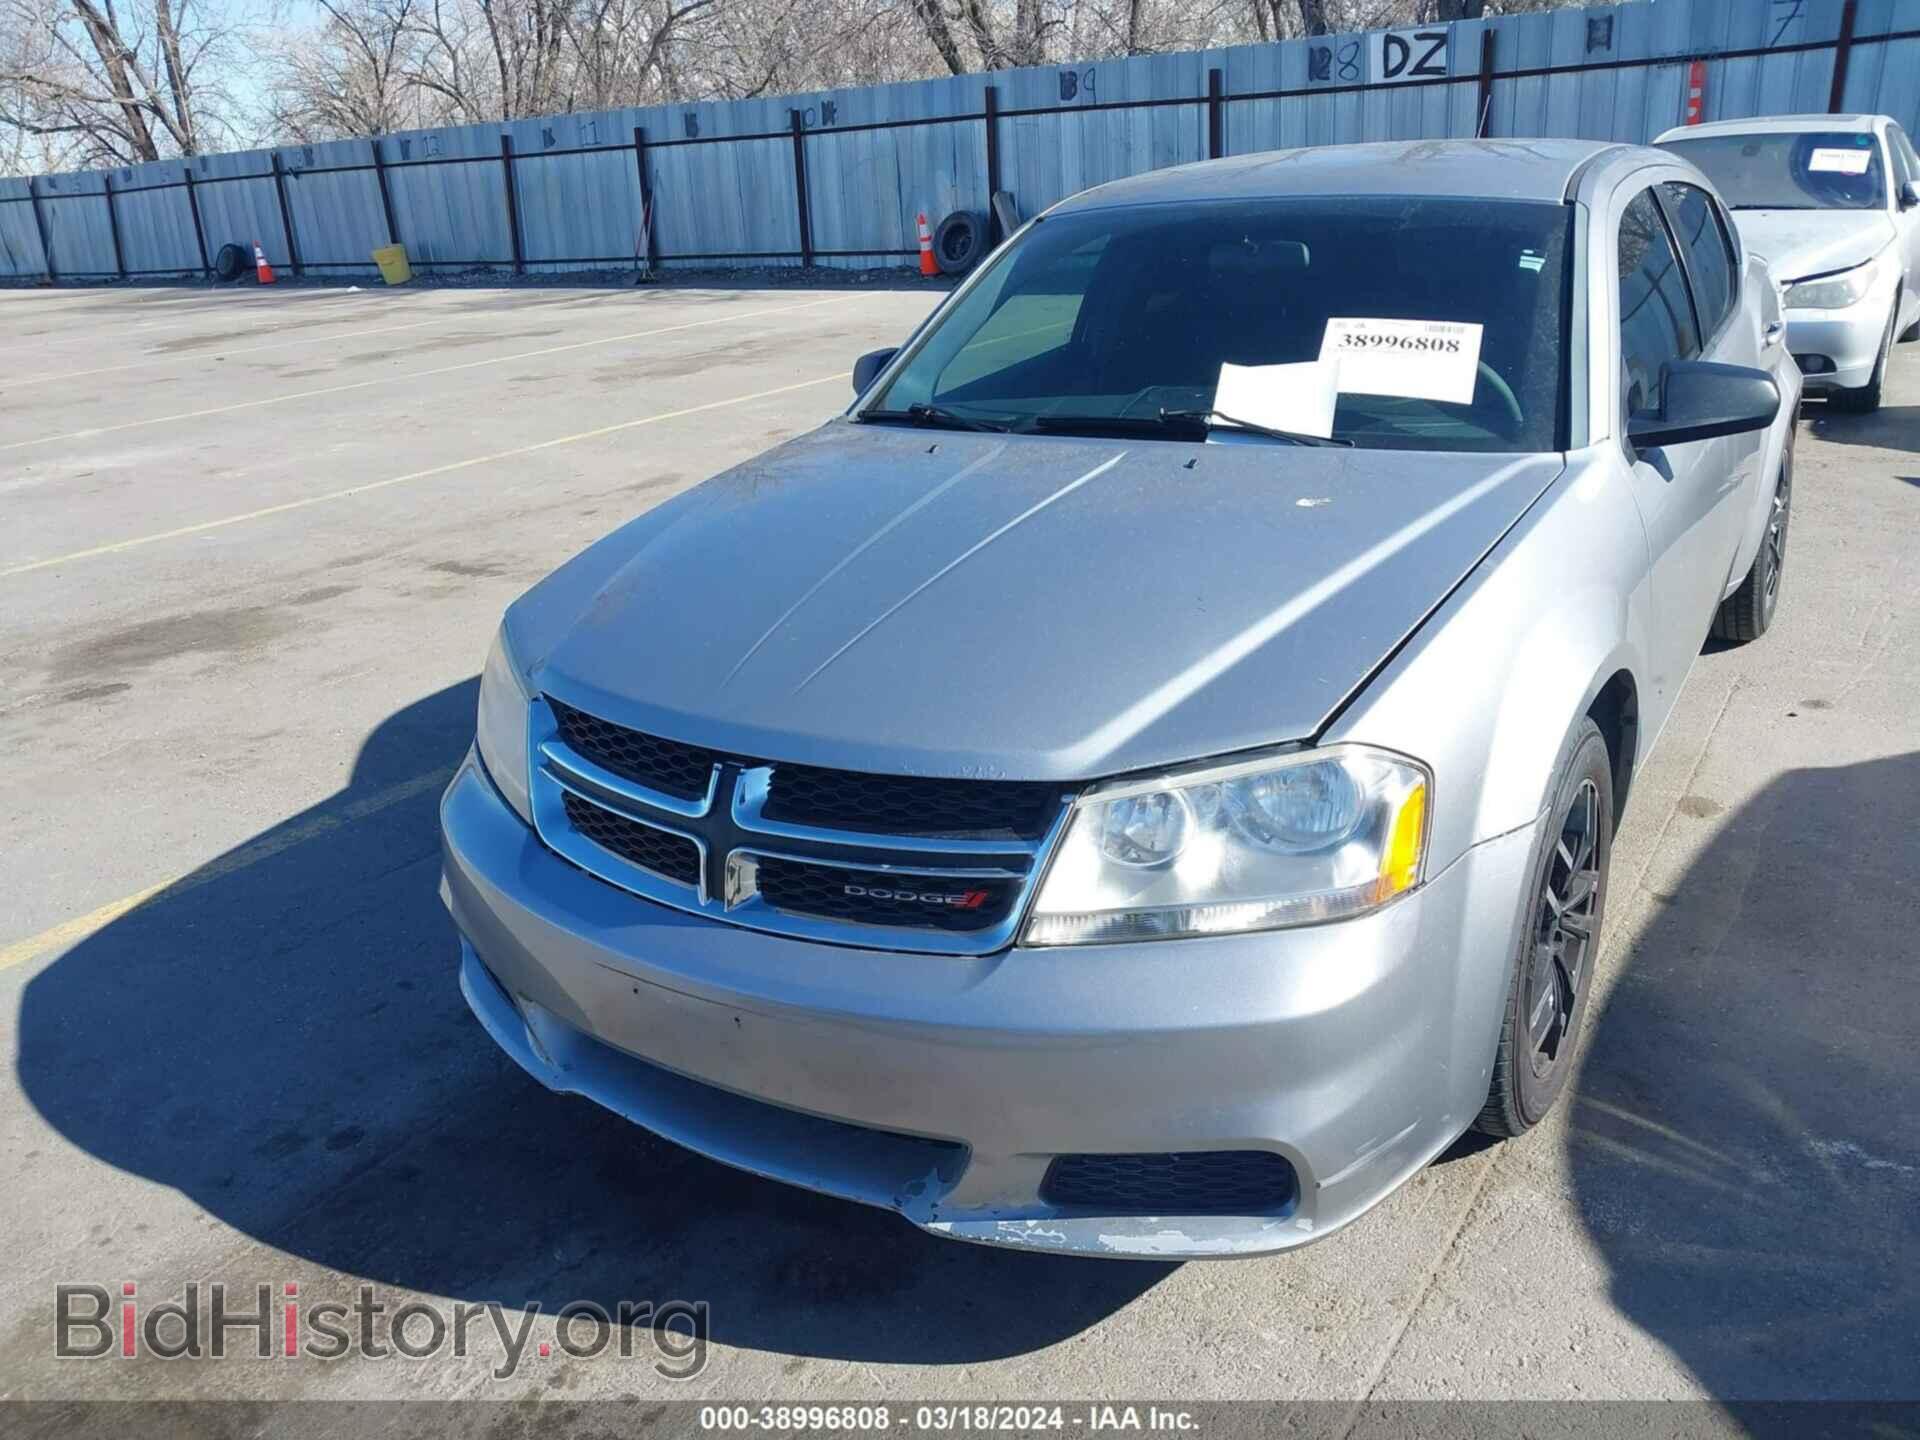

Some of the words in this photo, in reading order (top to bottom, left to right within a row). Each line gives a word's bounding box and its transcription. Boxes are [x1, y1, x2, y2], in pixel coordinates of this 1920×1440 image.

[1383, 33, 1448, 78] DZ
[1338, 333, 1460, 353] 38996808
[844, 885, 968, 904] DODGE
